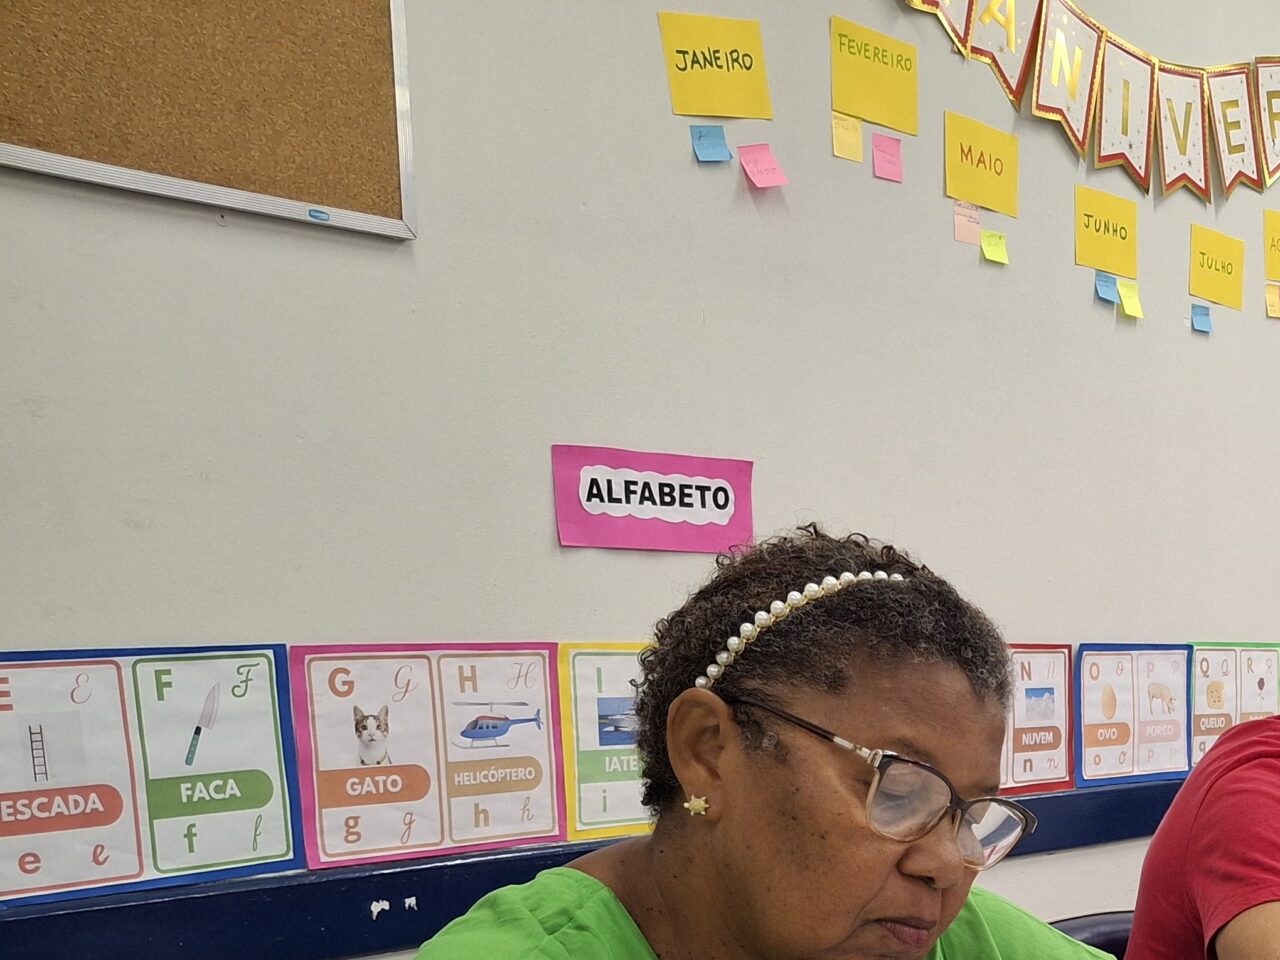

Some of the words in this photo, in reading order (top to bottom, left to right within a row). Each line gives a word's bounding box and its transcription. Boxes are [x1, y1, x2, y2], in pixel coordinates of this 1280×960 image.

[675, 48, 753, 73] JANEIRO
[838, 33, 912, 72] FEVEREIRO
[960, 142, 1004, 176] MAIO
[1084, 213, 1128, 241] JUNHO
[1199, 251, 1233, 276] JULHO
[586, 478, 730, 510] ALFABETO
[1020, 661, 1032, 681] N
[1089, 662, 1100, 681] O
[1200, 657, 1210, 678] Q
[1247, 657, 1255, 674] R
[154, 669, 173, 701] F
[231, 663, 260, 698] F
[328, 667, 355, 698] G
[457, 664, 478, 694] H
[1097, 728, 1118, 740] OVO
[1146, 724, 1174, 737] PORCO
[1200, 717, 1226, 730] QUEIJO
[1022, 731, 1054, 746] NUVEM
[454, 766, 536, 786] HELICÓPTERO
[605, 756, 639, 773] IATE
[1023, 758, 1033, 773] n
[180, 778, 242, 803] FACA
[345, 775, 403, 797] GATO
[0, 792, 104, 821] ESCADA
[602, 789, 608, 813] i
[474, 802, 490, 828] h
[183, 823, 198, 853] f
[343, 815, 362, 844] g
[18, 852, 42, 875] e
